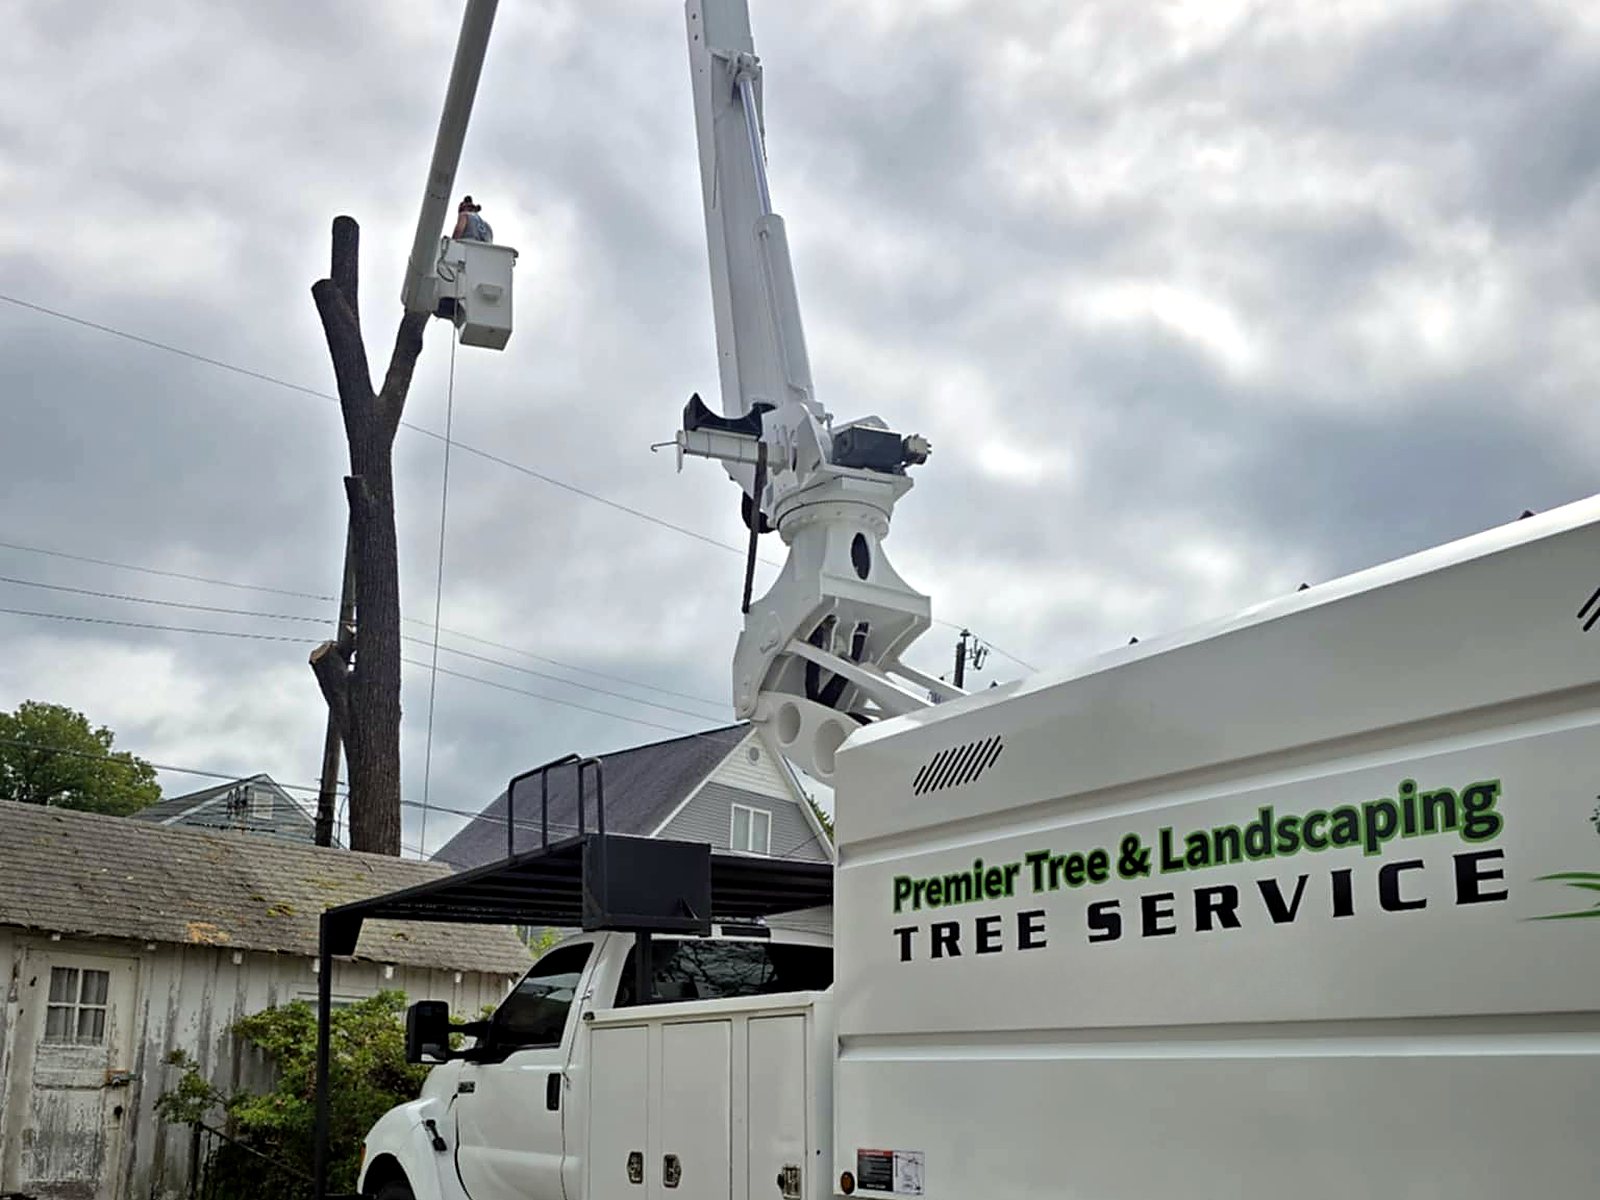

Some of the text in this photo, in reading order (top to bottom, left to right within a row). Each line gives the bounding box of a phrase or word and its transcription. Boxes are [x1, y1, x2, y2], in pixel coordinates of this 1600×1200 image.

[893, 779, 1503, 913] Premier Tree & Landscaping
[894, 850, 1508, 961] TREE SERVICE
